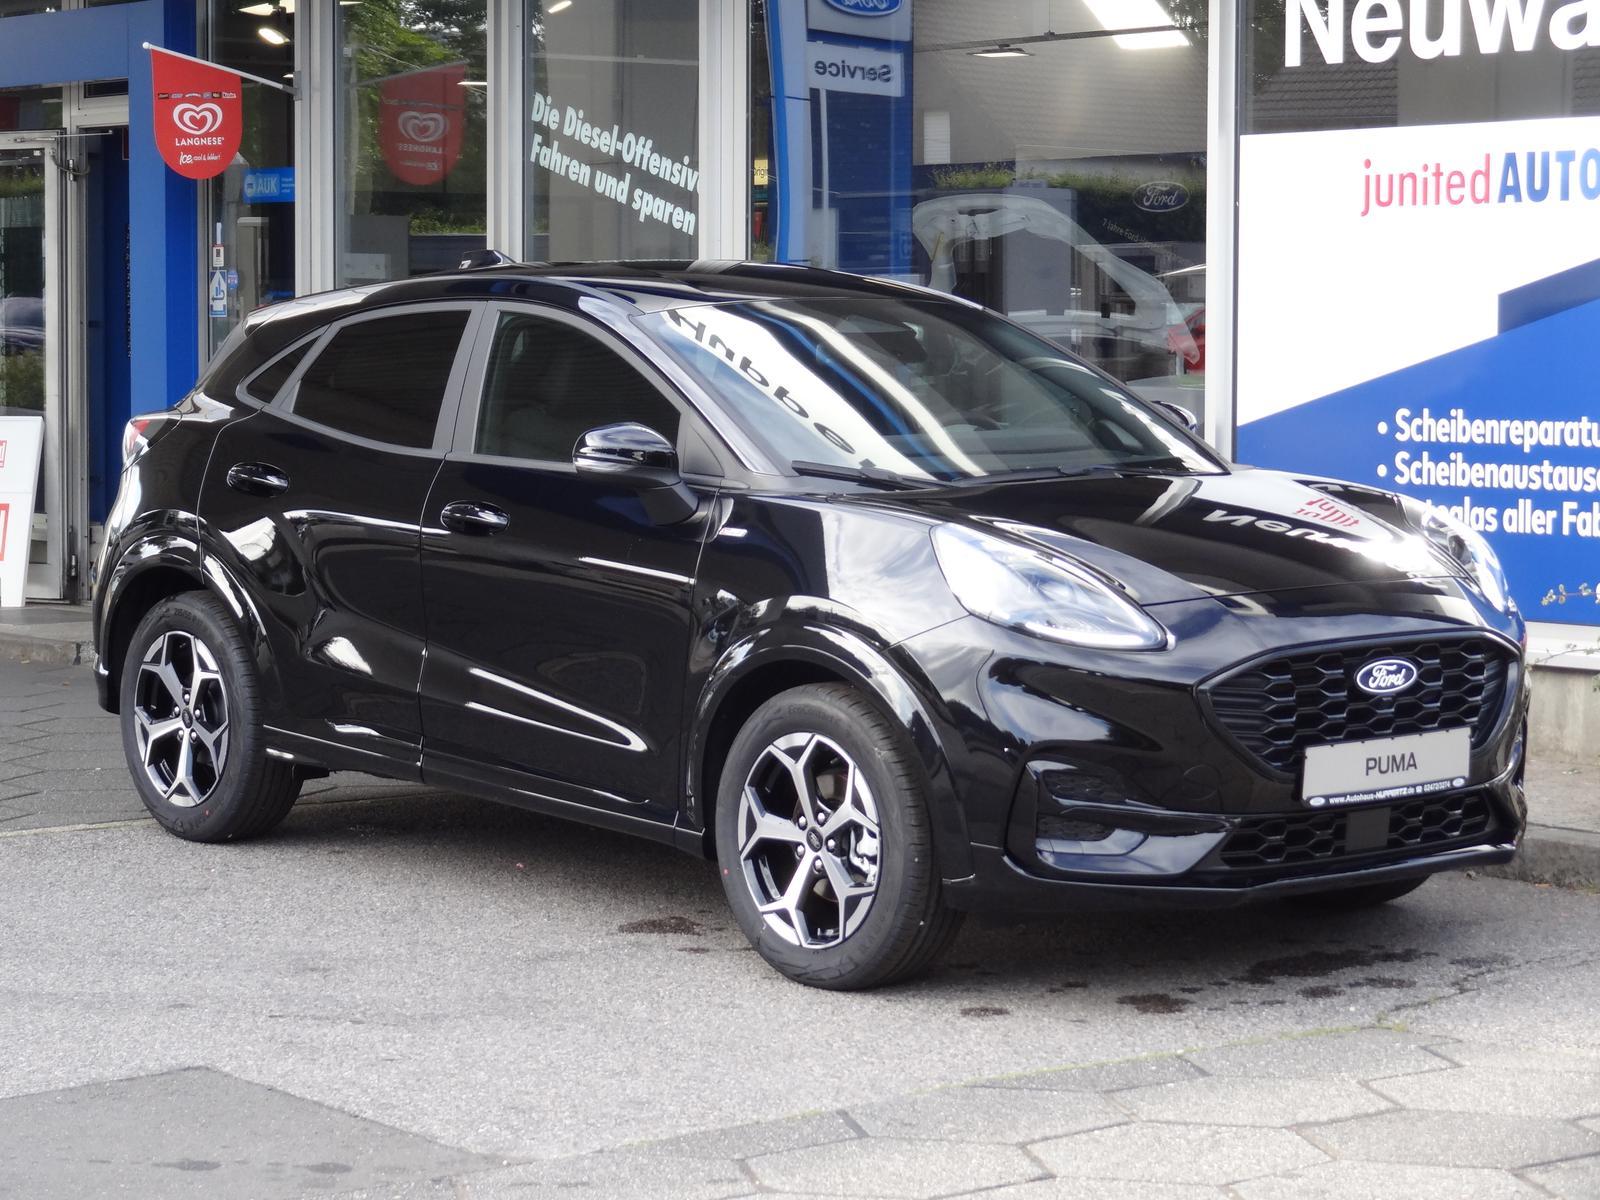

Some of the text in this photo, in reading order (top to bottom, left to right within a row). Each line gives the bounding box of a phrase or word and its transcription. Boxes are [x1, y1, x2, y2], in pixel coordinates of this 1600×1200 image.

[175, 136, 222, 146] LANGNESE
[531, 92, 700, 195] Die Diesel-Offensiv
[530, 133, 696, 236] Fahren und sparen
[1143, 185, 1178, 206] Ford
[1502, 498, 1557, 535] aller
[1368, 665, 1406, 688] Ford
[1366, 752, 1417, 776] PUMA
